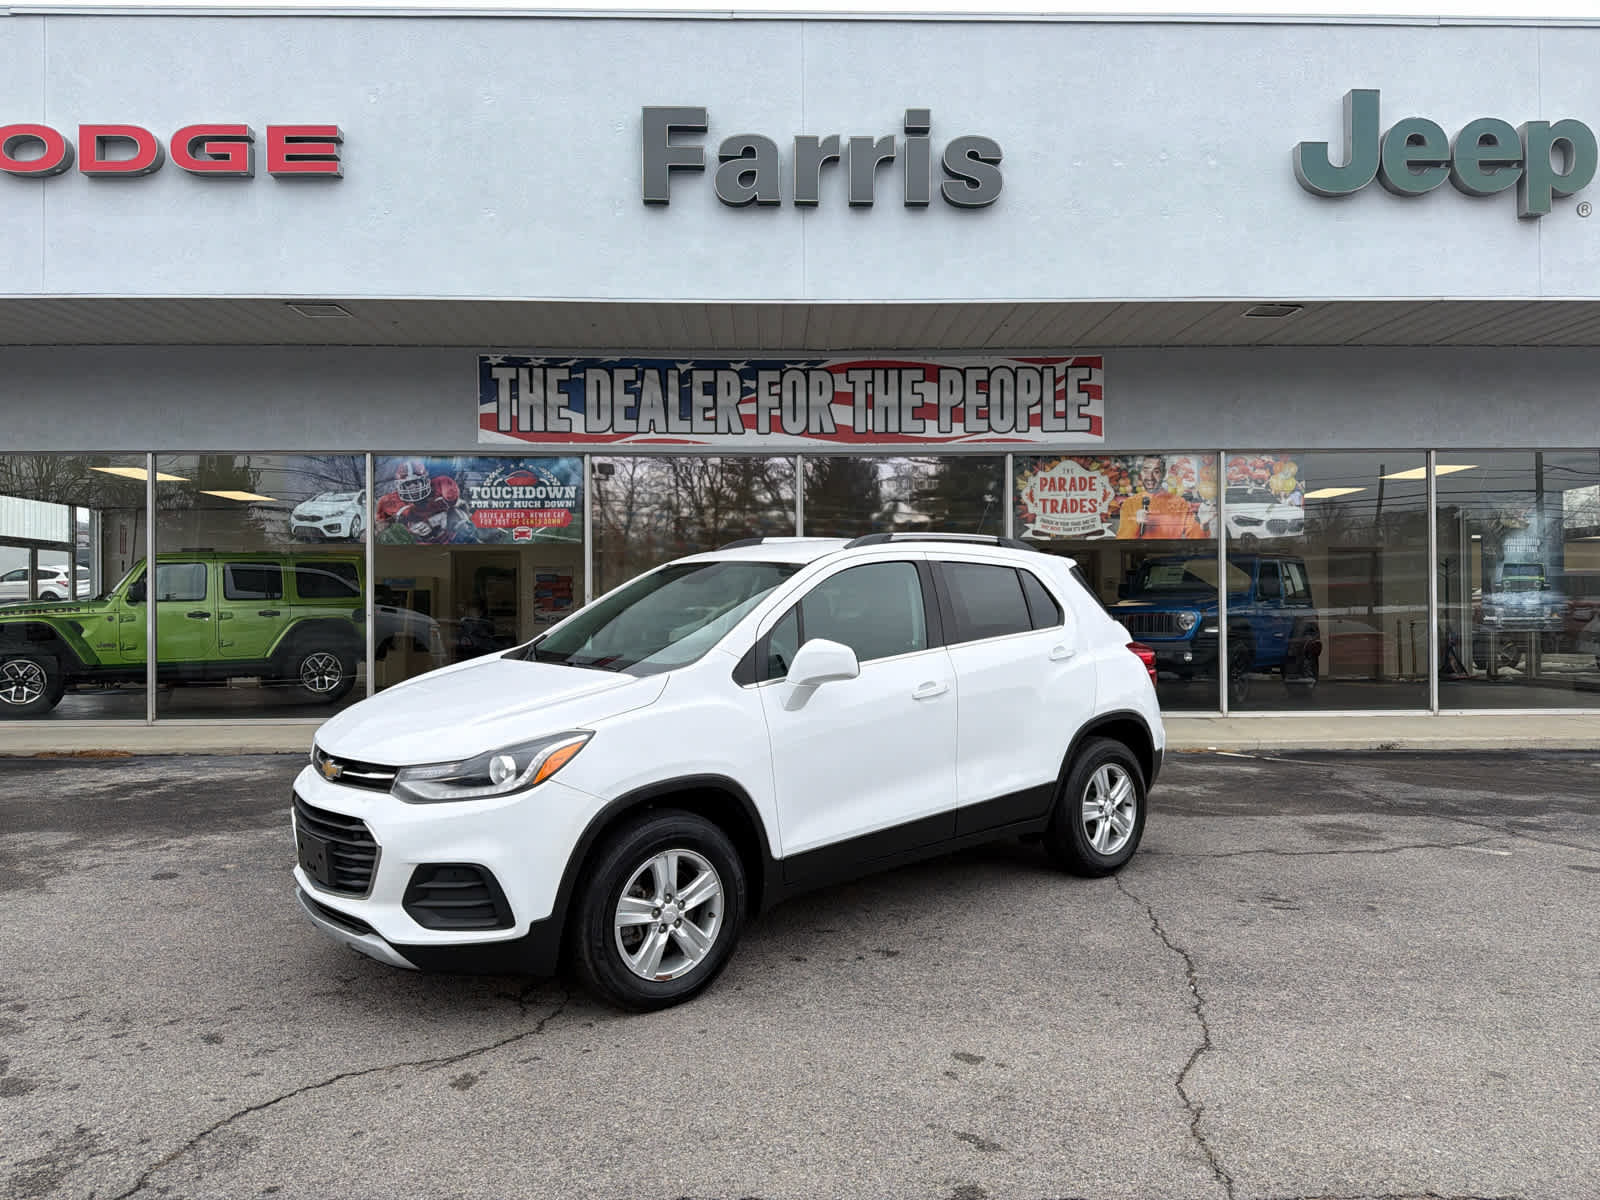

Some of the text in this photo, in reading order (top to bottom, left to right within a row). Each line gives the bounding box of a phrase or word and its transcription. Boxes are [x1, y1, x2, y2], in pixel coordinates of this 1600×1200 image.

[0, 123, 343, 177] ODGE
[641, 105, 1003, 208] Farris
[1293, 89, 1598, 218] Jeep
[491, 366, 1092, 434] THE DEALER FOR THE PEOPLE
[469, 486, 577, 499] TOUCHDOWN
[1039, 498, 1098, 514] TRADES
[1040, 476, 1097, 492] PARADE
